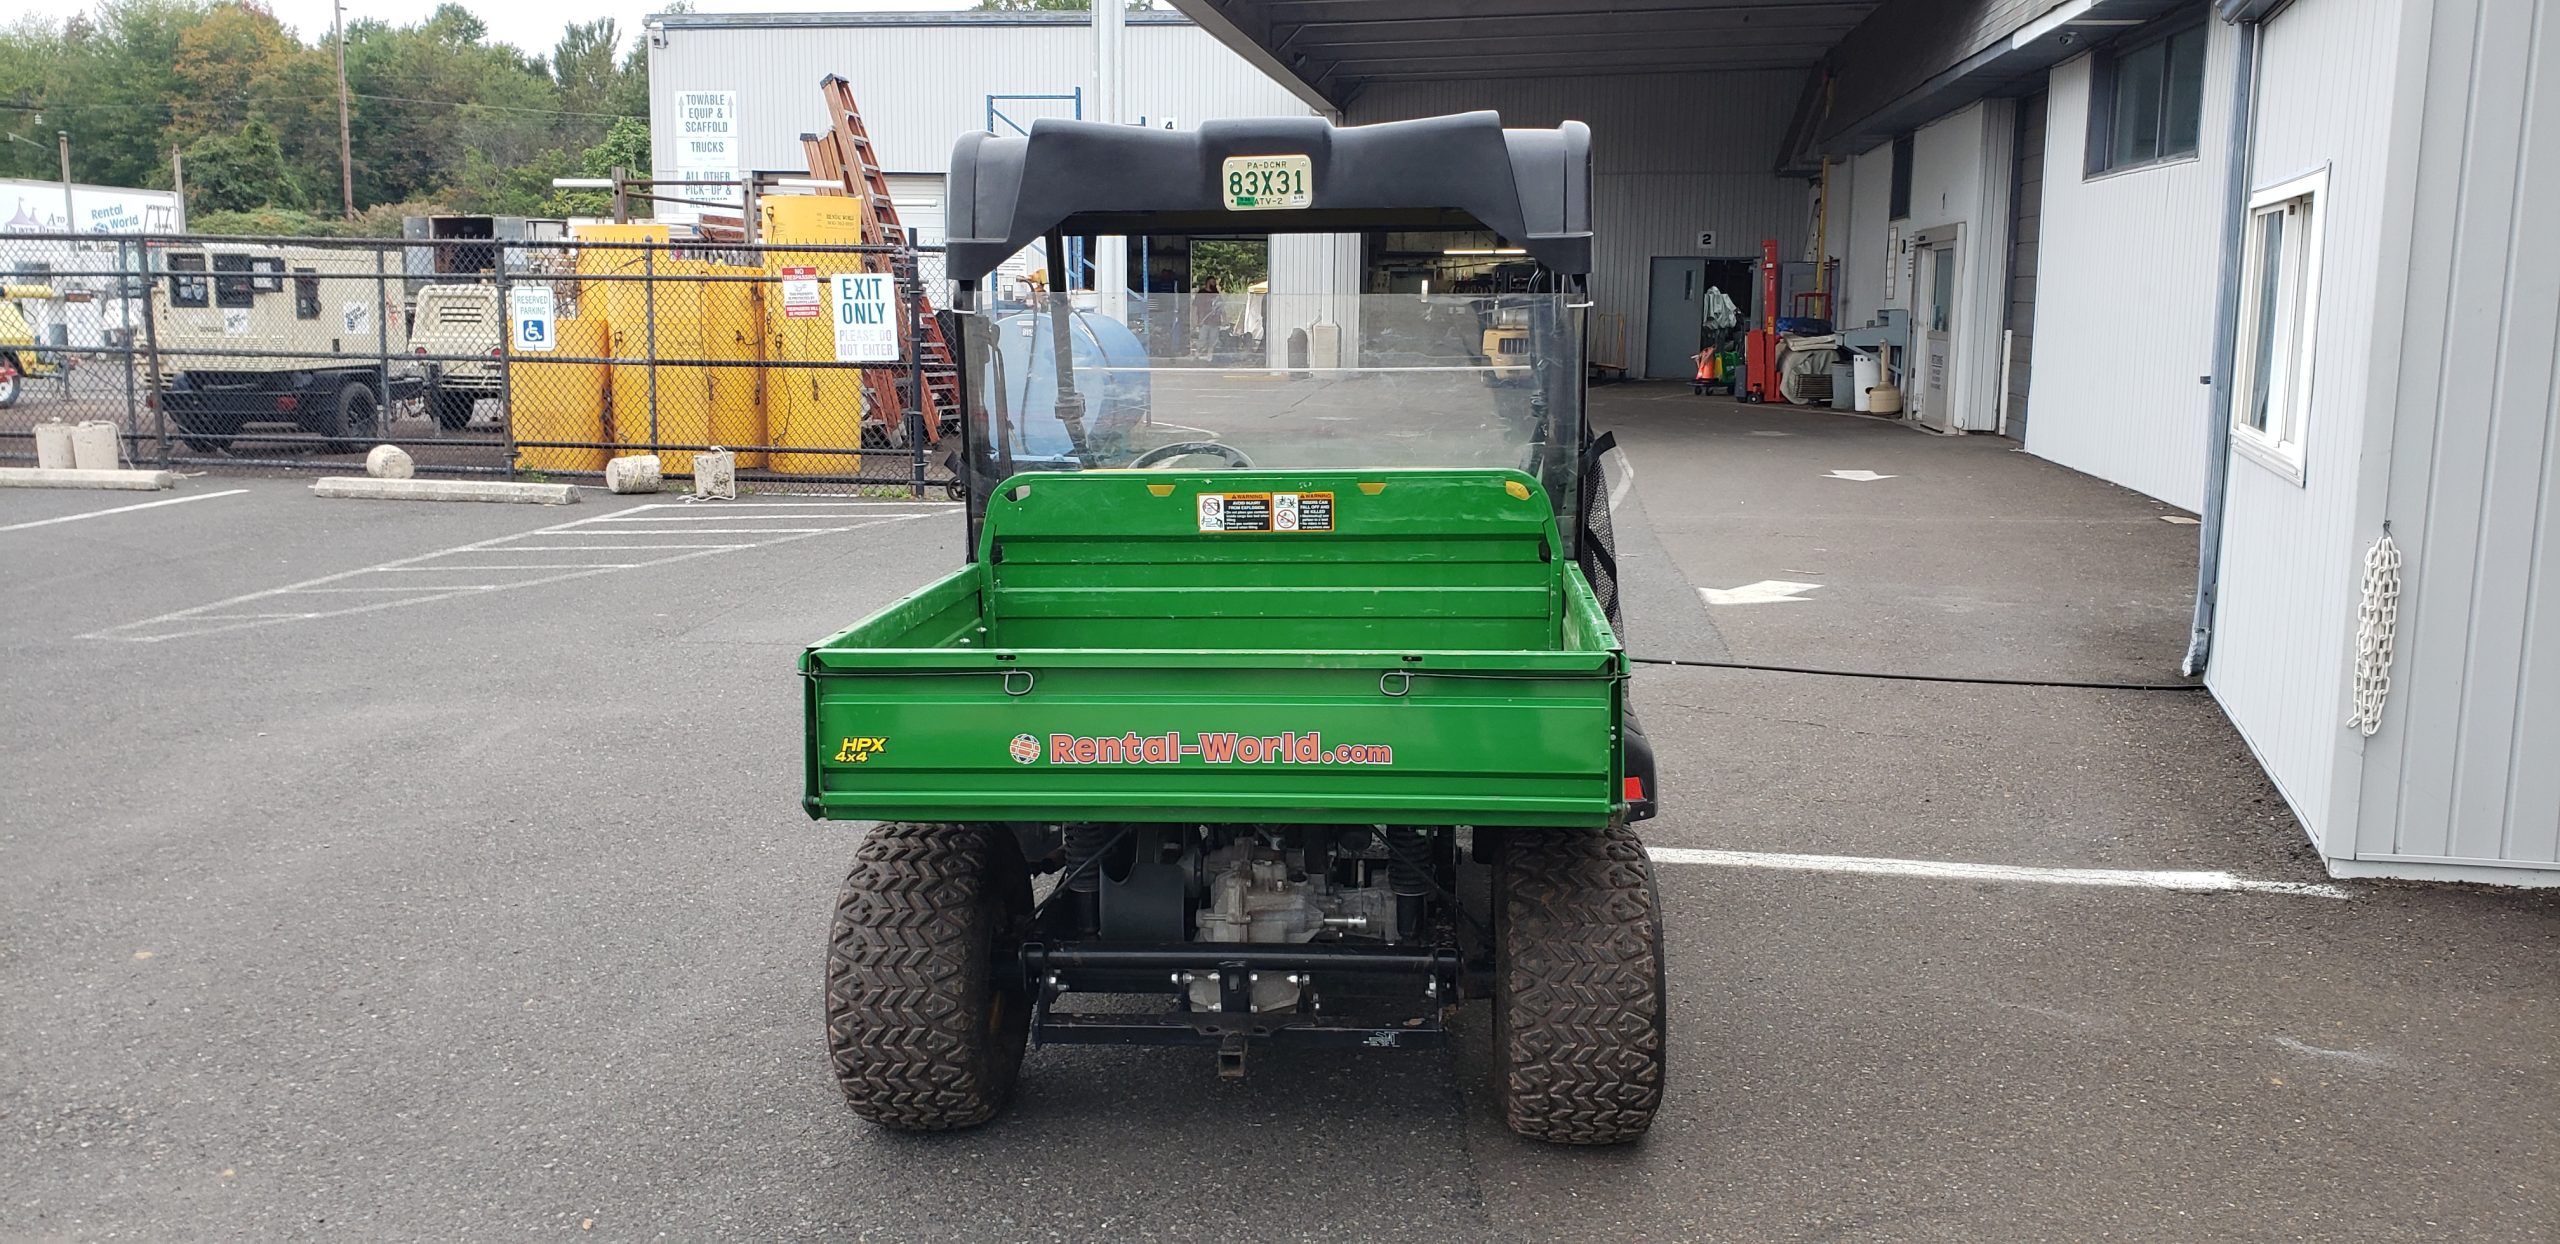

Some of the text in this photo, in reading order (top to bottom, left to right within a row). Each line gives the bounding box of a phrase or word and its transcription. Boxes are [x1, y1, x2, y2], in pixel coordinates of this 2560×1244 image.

[686, 94, 725, 106] TOWABLE
[688, 107, 723, 120] EQUIP &
[685, 121, 728, 133] SCAFFOLD
[690, 141, 724, 153] TRUCKS
[1247, 160, 1287, 169] PA-DCNR
[686, 171, 730, 182] ALL OTHER
[1229, 169, 1304, 196] 83X31
[685, 184, 732, 196] PICK-UP &
[91, 204, 123, 220] Rental
[109, 214, 139, 229] World
[1702, 234, 1712, 244] 2
[842, 278, 882, 300] EXIT
[516, 295, 548, 304] RESERVED
[520, 306, 546, 316] PARKING
[842, 302, 886, 324] ONLY
[839, 330, 892, 342] PLEASE DO
[840, 344, 893, 356] NOT ENTER
[841, 737, 887, 752] HPX
[1049, 732, 1392, 764] Rental-World.com
[834, 752, 868, 763] 4x4
